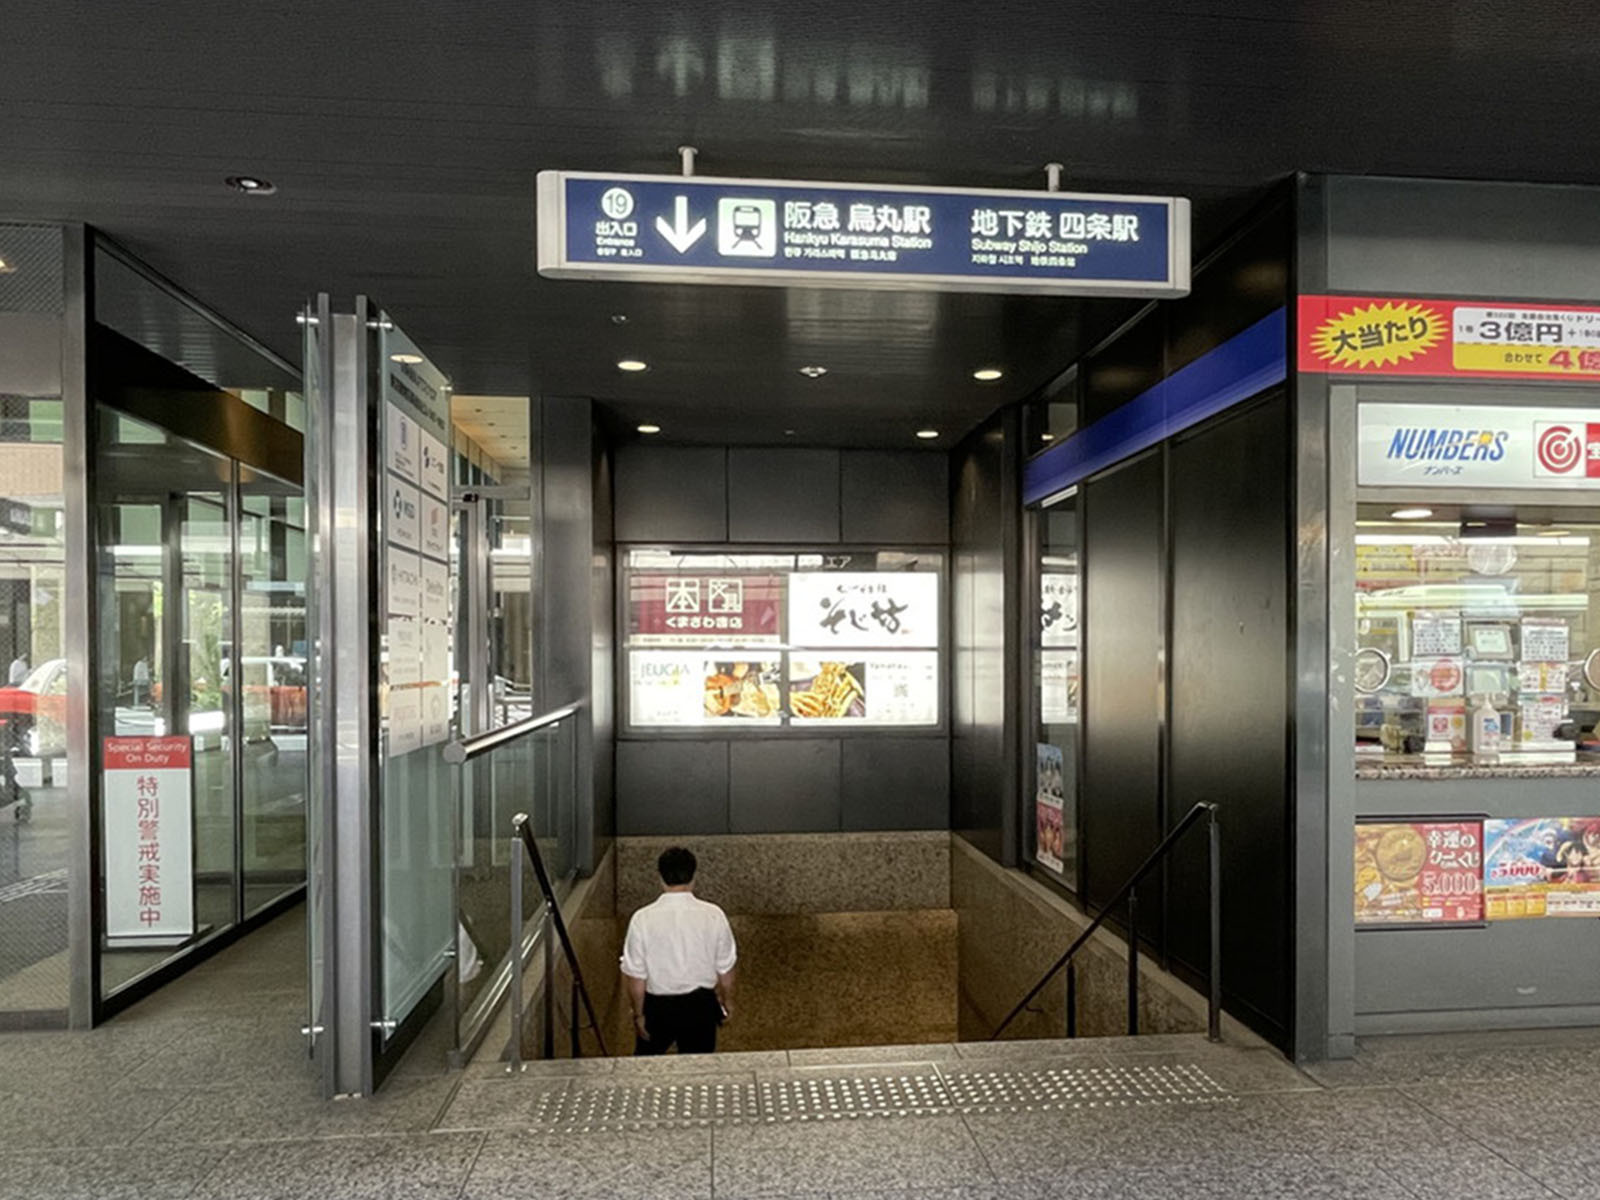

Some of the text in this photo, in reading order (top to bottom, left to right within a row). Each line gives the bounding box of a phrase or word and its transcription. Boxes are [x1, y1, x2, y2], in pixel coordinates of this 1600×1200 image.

[605, 193, 628, 215] 19
[784, 201, 840, 229] 阪急
[971, 209, 1139, 241] 地下鉄 四条駅
[596, 221, 637, 236] 出入口
[784, 231, 829, 246] Hankyu
[892, 236, 932, 248] Station
[971, 238, 1088, 255] Subway Shijo Station
[1331, 316, 1428, 354] 大当たり
[1479, 321, 1563, 342] 3億円
[1504, 352, 1543, 363] 合わせて
[1387, 428, 1509, 461] NUMBERS
[107, 742, 187, 754] Special Security
[125, 754, 169, 764] On Duty
[137, 776, 161, 927] 特別警戒実施中
